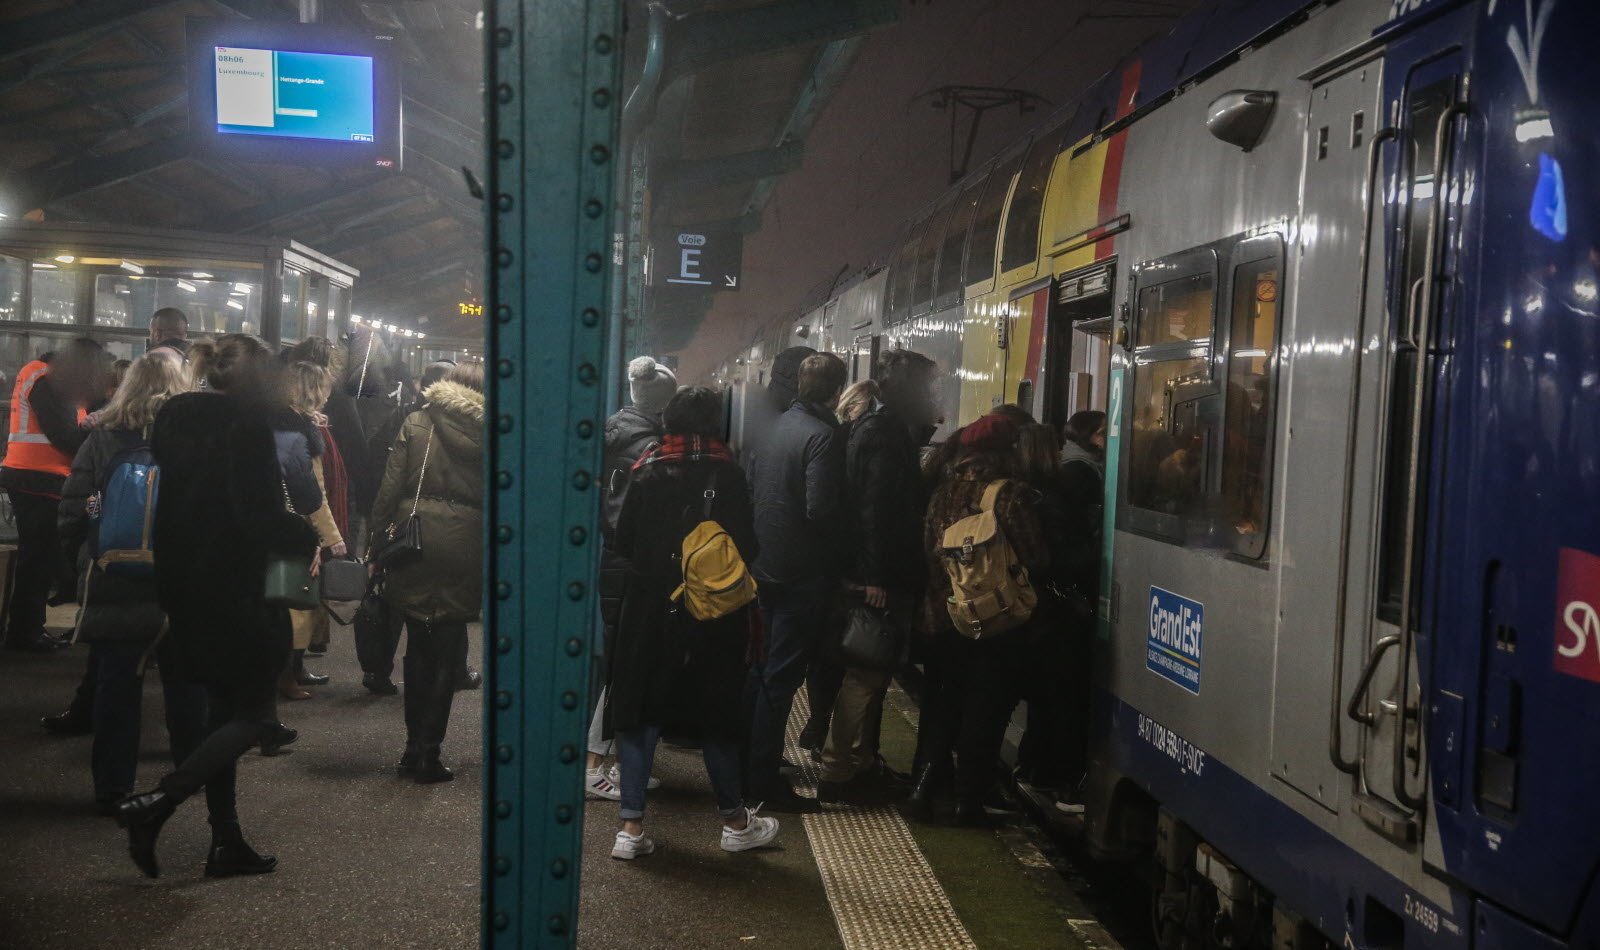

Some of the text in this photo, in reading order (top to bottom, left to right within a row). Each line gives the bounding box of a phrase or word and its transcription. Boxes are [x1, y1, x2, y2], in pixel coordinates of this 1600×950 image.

[218, 55, 244, 63] 08h06
[218, 68, 265, 78] Luxembourg
[681, 235, 702, 244] Voie
[680, 248, 701, 278] E
[1110, 376, 1120, 437] 2
[1138, 713, 1145, 738] 94
